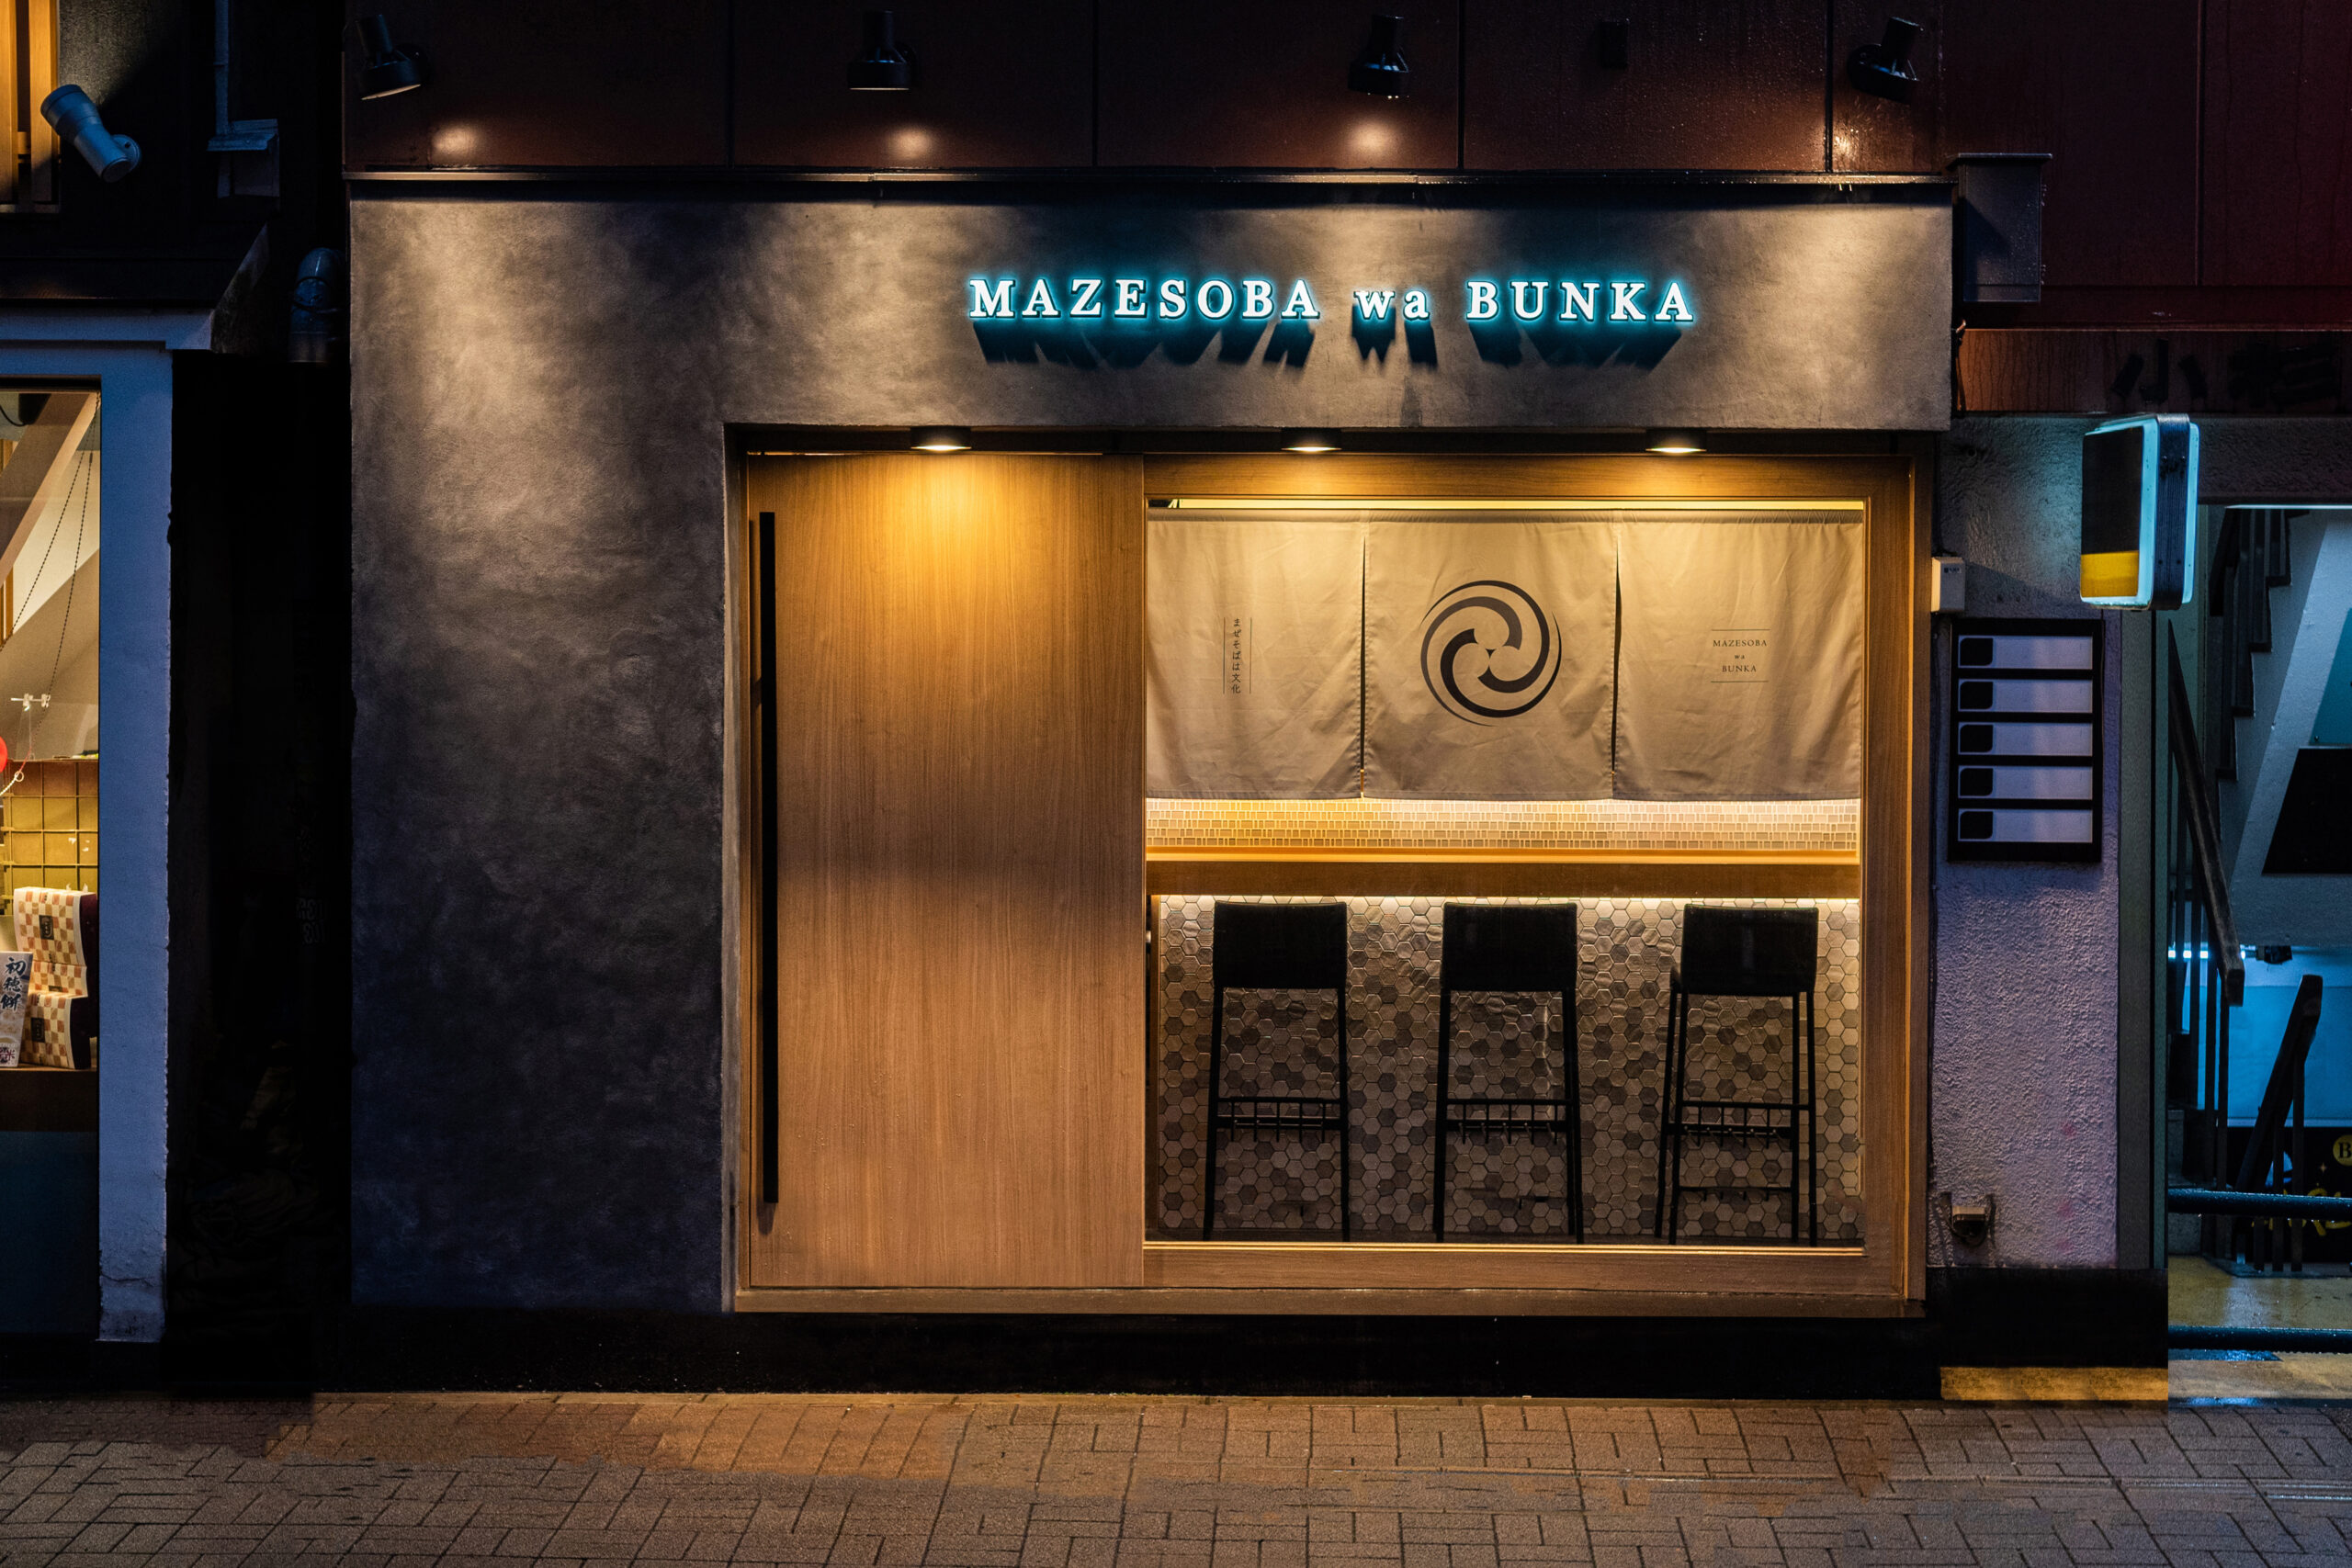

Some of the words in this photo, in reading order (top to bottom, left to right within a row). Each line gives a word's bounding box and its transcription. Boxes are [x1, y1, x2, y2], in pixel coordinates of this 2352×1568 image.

[969, 278, 1321, 319] MAZESOBA
[1353, 289, 1430, 321] wa
[1466, 281, 1695, 322] BUNKA
[1231, 618, 1241, 694] まぜそばは文化
